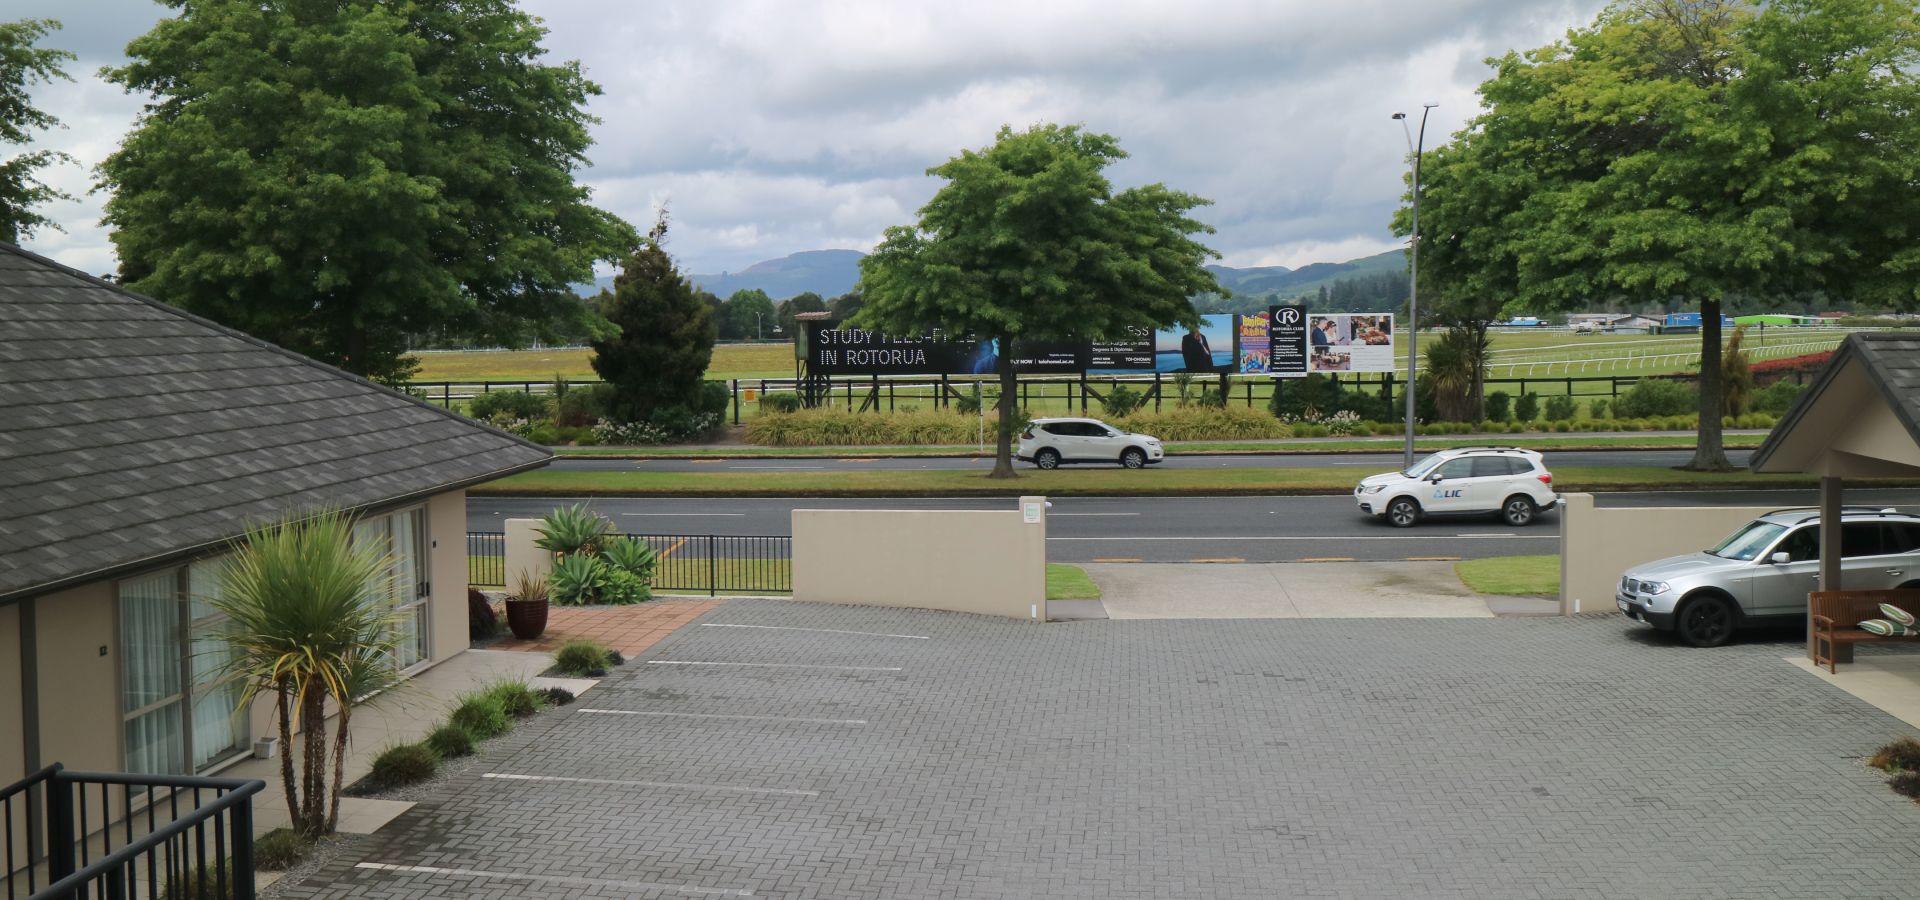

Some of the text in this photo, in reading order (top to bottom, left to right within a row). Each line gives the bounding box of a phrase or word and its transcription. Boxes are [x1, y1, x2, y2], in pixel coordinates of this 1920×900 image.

[820, 328, 872, 344] STUDY
[821, 350, 926, 364] IN ROTORUA
[1444, 490, 1463, 498] LIC
